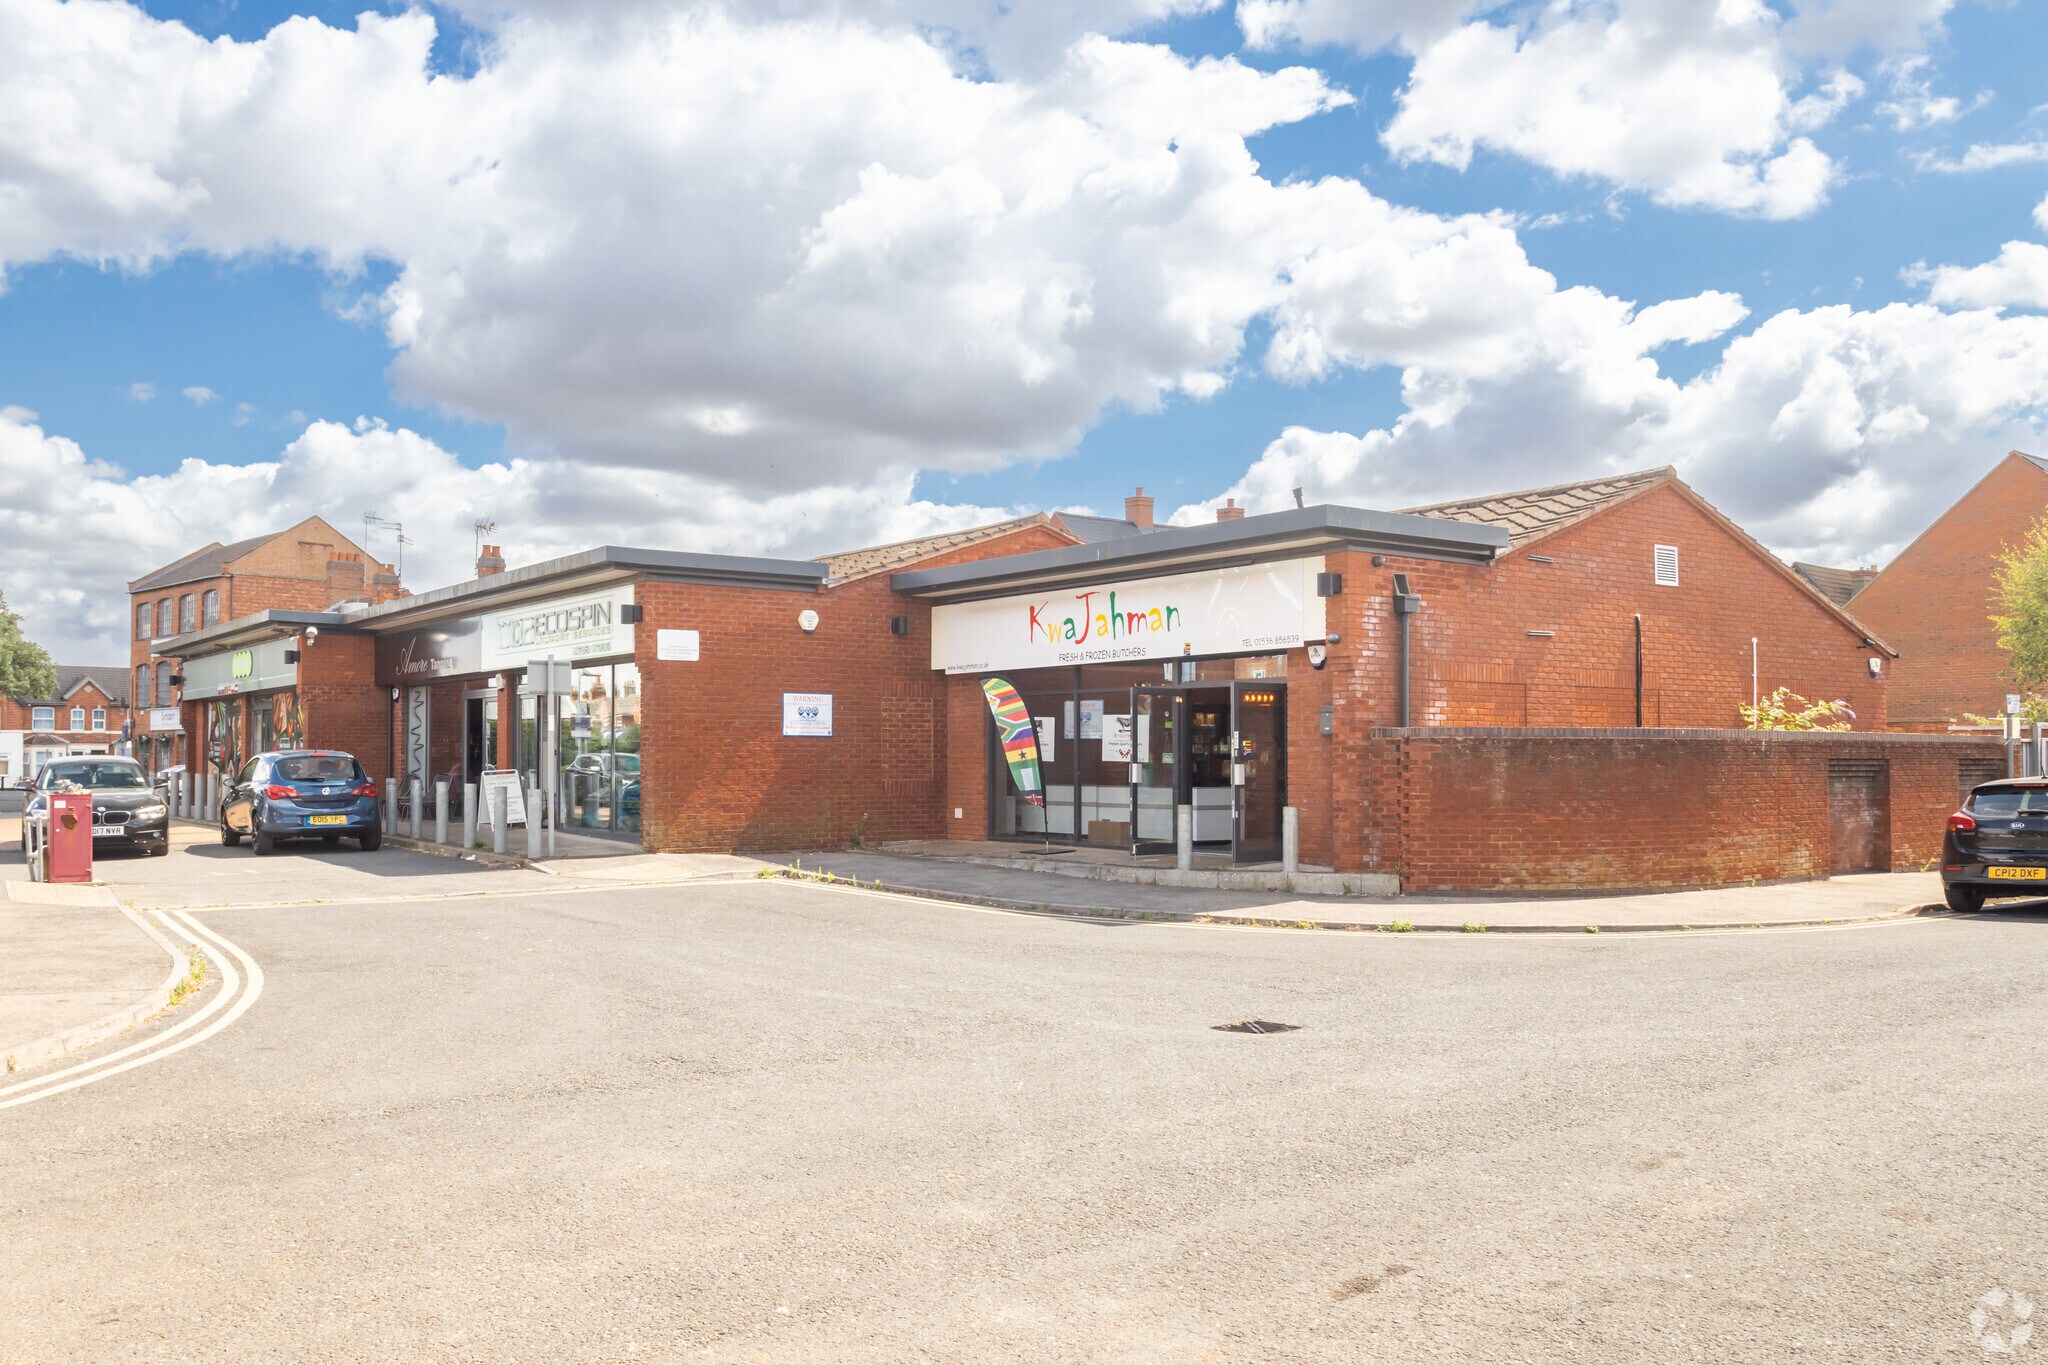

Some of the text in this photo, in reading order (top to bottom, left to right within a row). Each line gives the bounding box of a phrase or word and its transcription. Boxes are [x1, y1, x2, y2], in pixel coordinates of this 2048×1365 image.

[534, 601, 611, 636] ECOSPIN
[1029, 591, 1181, 645] KwaJahman
[1254, 636, 1273, 646] 01536
[1275, 634, 1300, 645] 856539
[1059, 653, 1078, 662] FRESH
[1085, 650, 1111, 661] FROZEN
[1112, 647, 1146, 659] BUTCHERS
[1995, 868, 2040, 878] CP12 DXF
